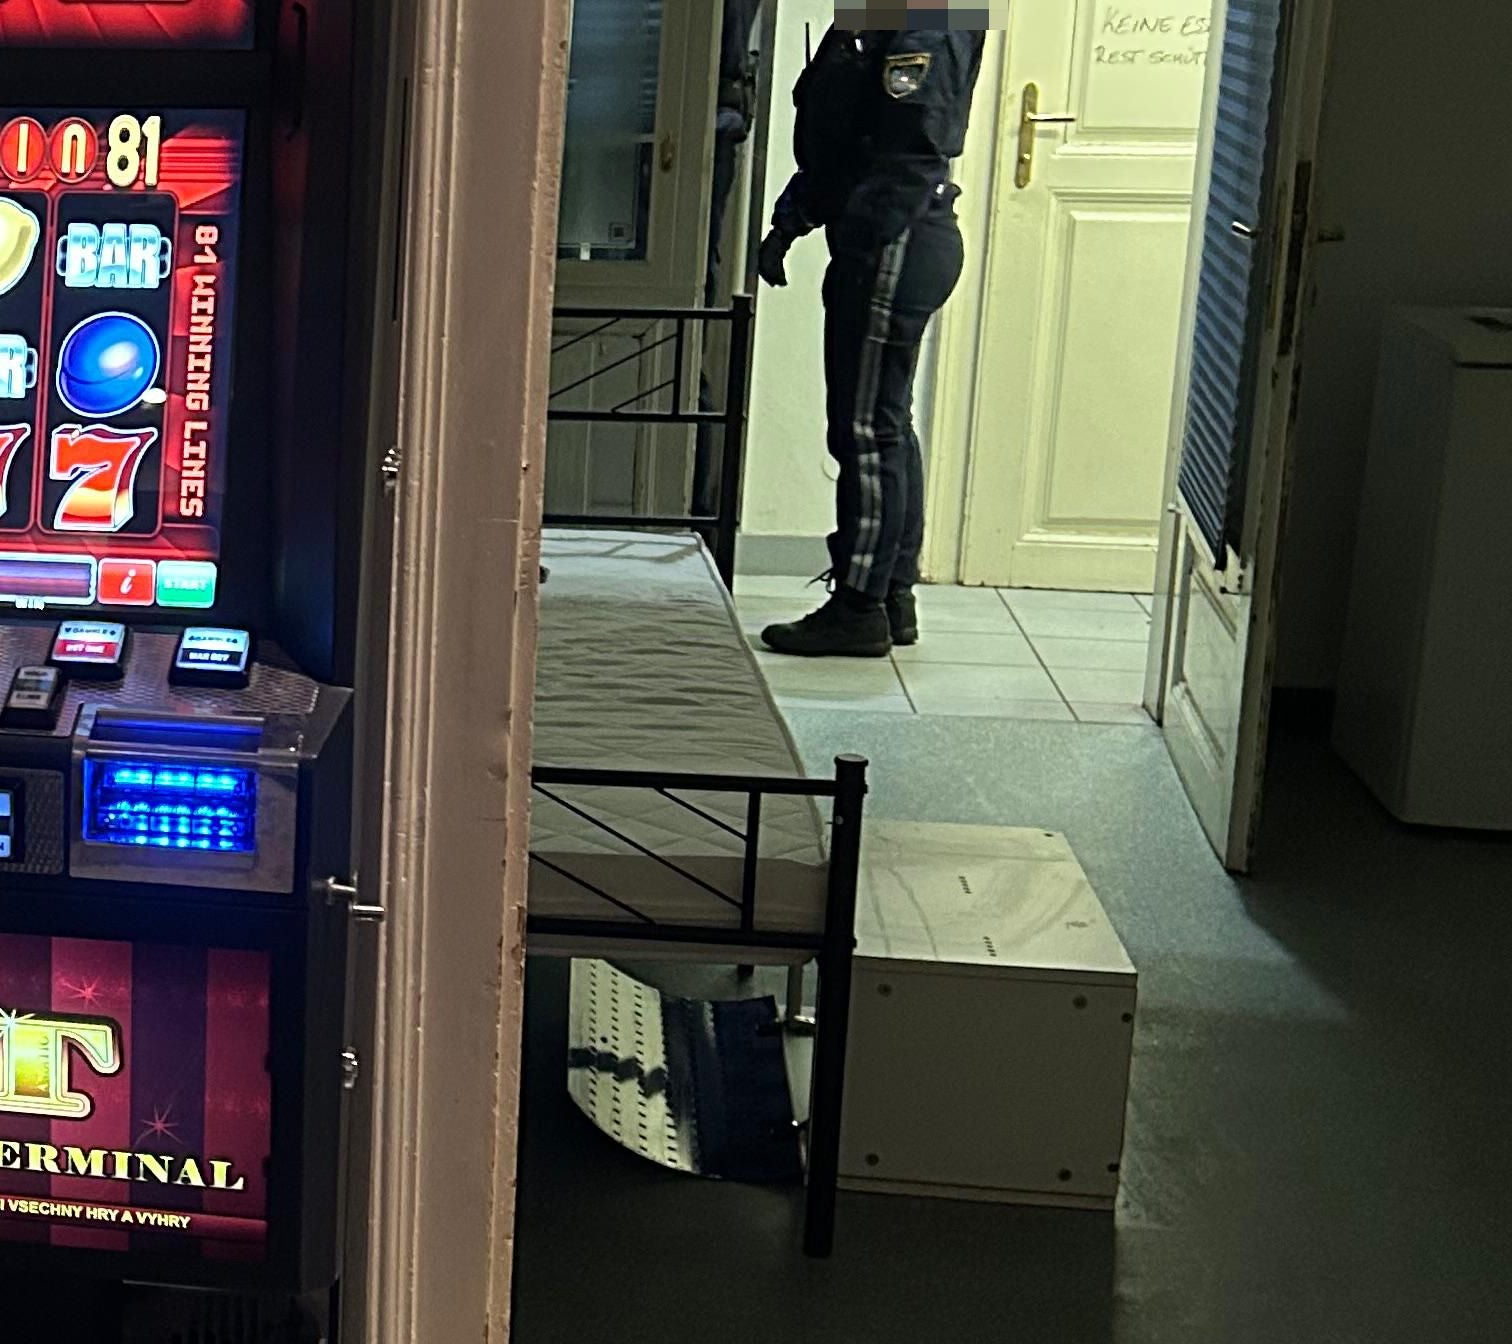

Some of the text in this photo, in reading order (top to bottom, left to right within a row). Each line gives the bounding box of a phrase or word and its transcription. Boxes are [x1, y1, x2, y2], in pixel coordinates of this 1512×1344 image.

[1102, 6, 1210, 36] KEINE ES
[107, 114, 161, 187] 81
[65, 223, 162, 289] BAR
[179, 224, 219, 519] 81 WINNING LINES
[8, 1200, 83, 1219] VSECHNY
[86, 1207, 119, 1222] HRY
[121, 1210, 133, 1223] A
[136, 1212, 190, 1229] VYHRY
